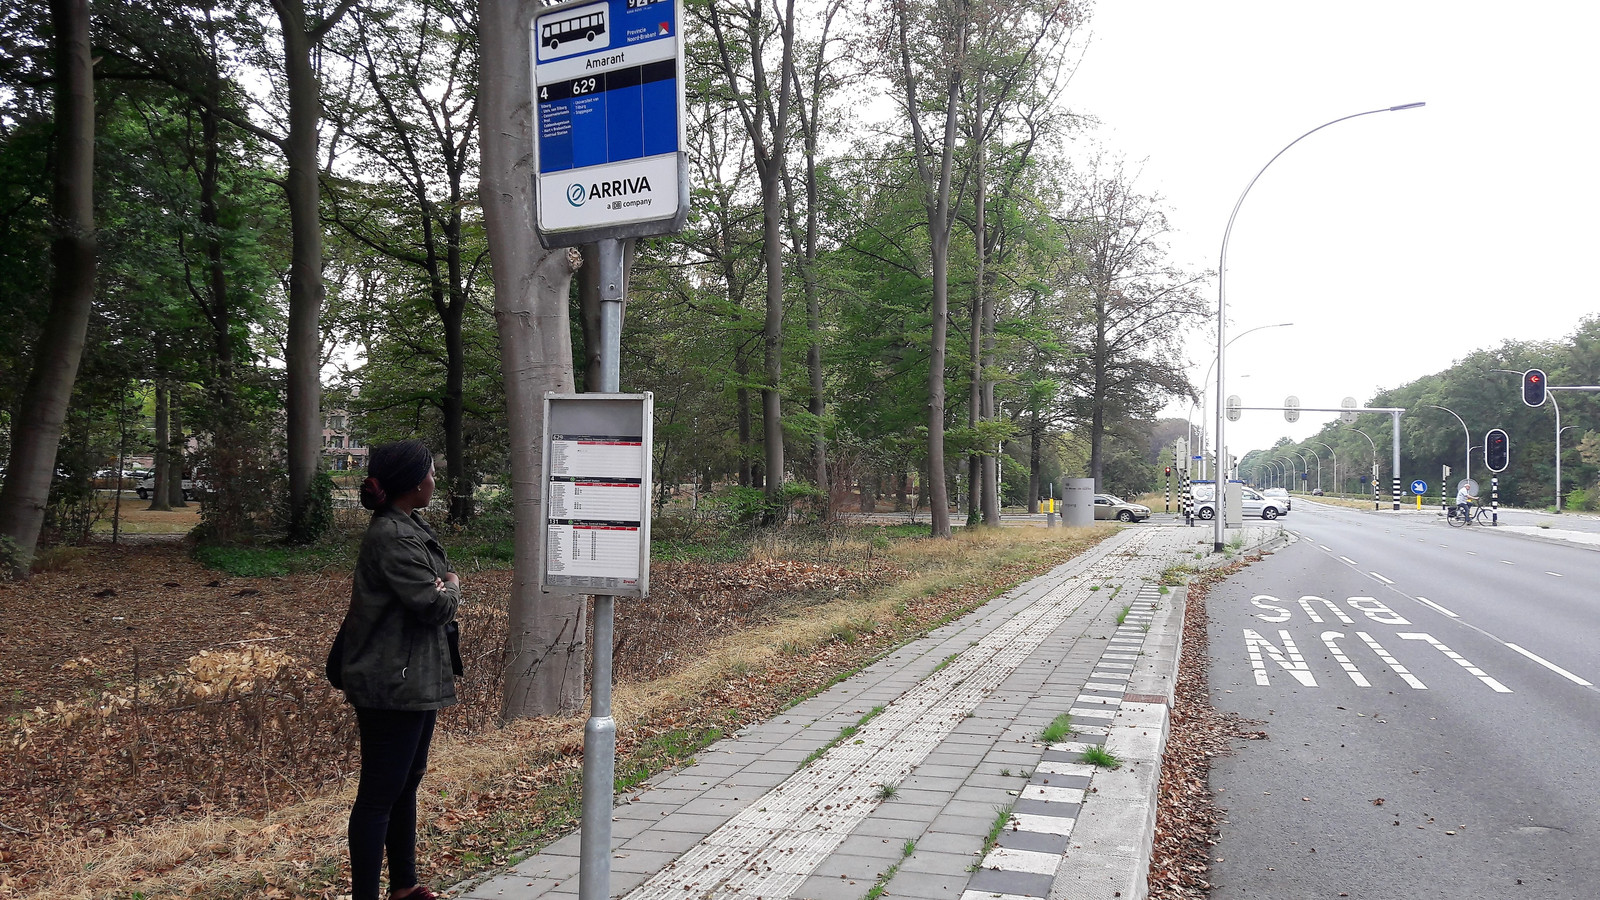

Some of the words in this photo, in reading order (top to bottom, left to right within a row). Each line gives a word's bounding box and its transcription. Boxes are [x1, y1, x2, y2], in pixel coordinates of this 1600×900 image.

[626, 32, 657, 42] Noord-Brabant
[627, 27, 647, 36] Provincie
[585, 51, 625, 70] Amarant
[540, 86, 549, 100] 4
[572, 78, 596, 95] 629
[588, 175, 652, 201] ARRIVA
[622, 198, 652, 209] company
[552, 433, 564, 441] 629
[1250, 594, 1413, 625] BUS
[1242, 628, 1515, 693] LIJN
